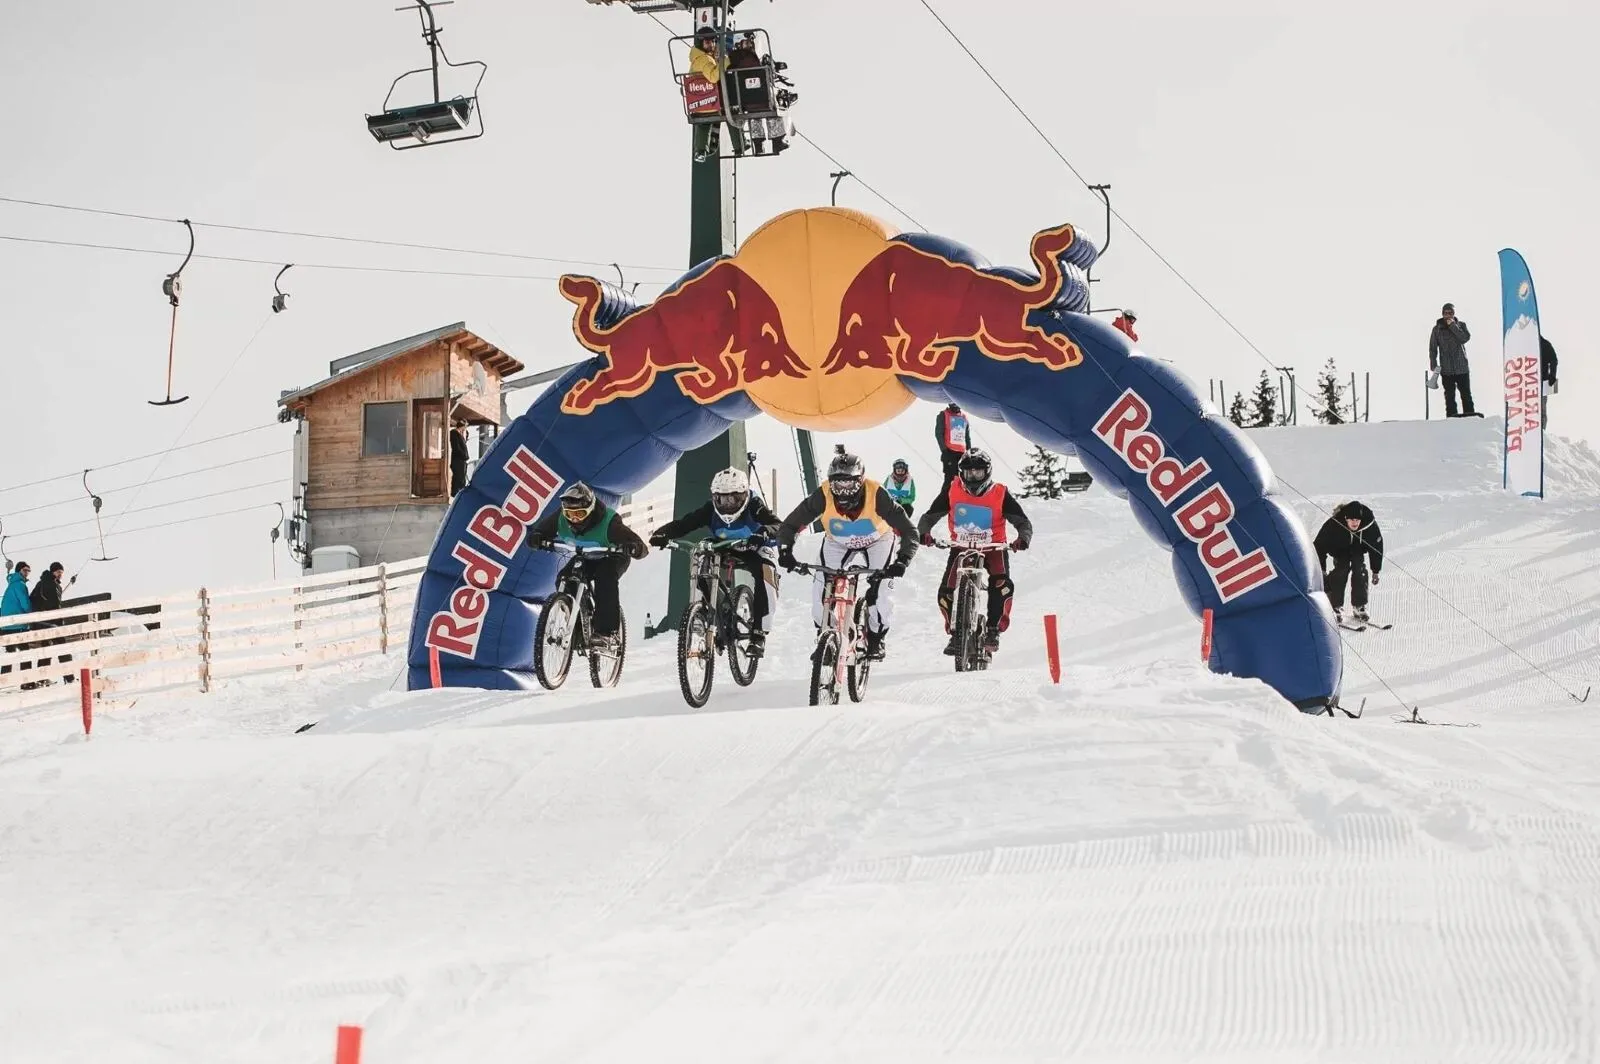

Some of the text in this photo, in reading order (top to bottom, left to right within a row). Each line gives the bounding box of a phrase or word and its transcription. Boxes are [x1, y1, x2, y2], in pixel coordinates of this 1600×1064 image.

[702, 10, 708, 24] 6
[427, 446, 562, 658] Red Bull
[1095, 390, 1276, 600] Red Bull
